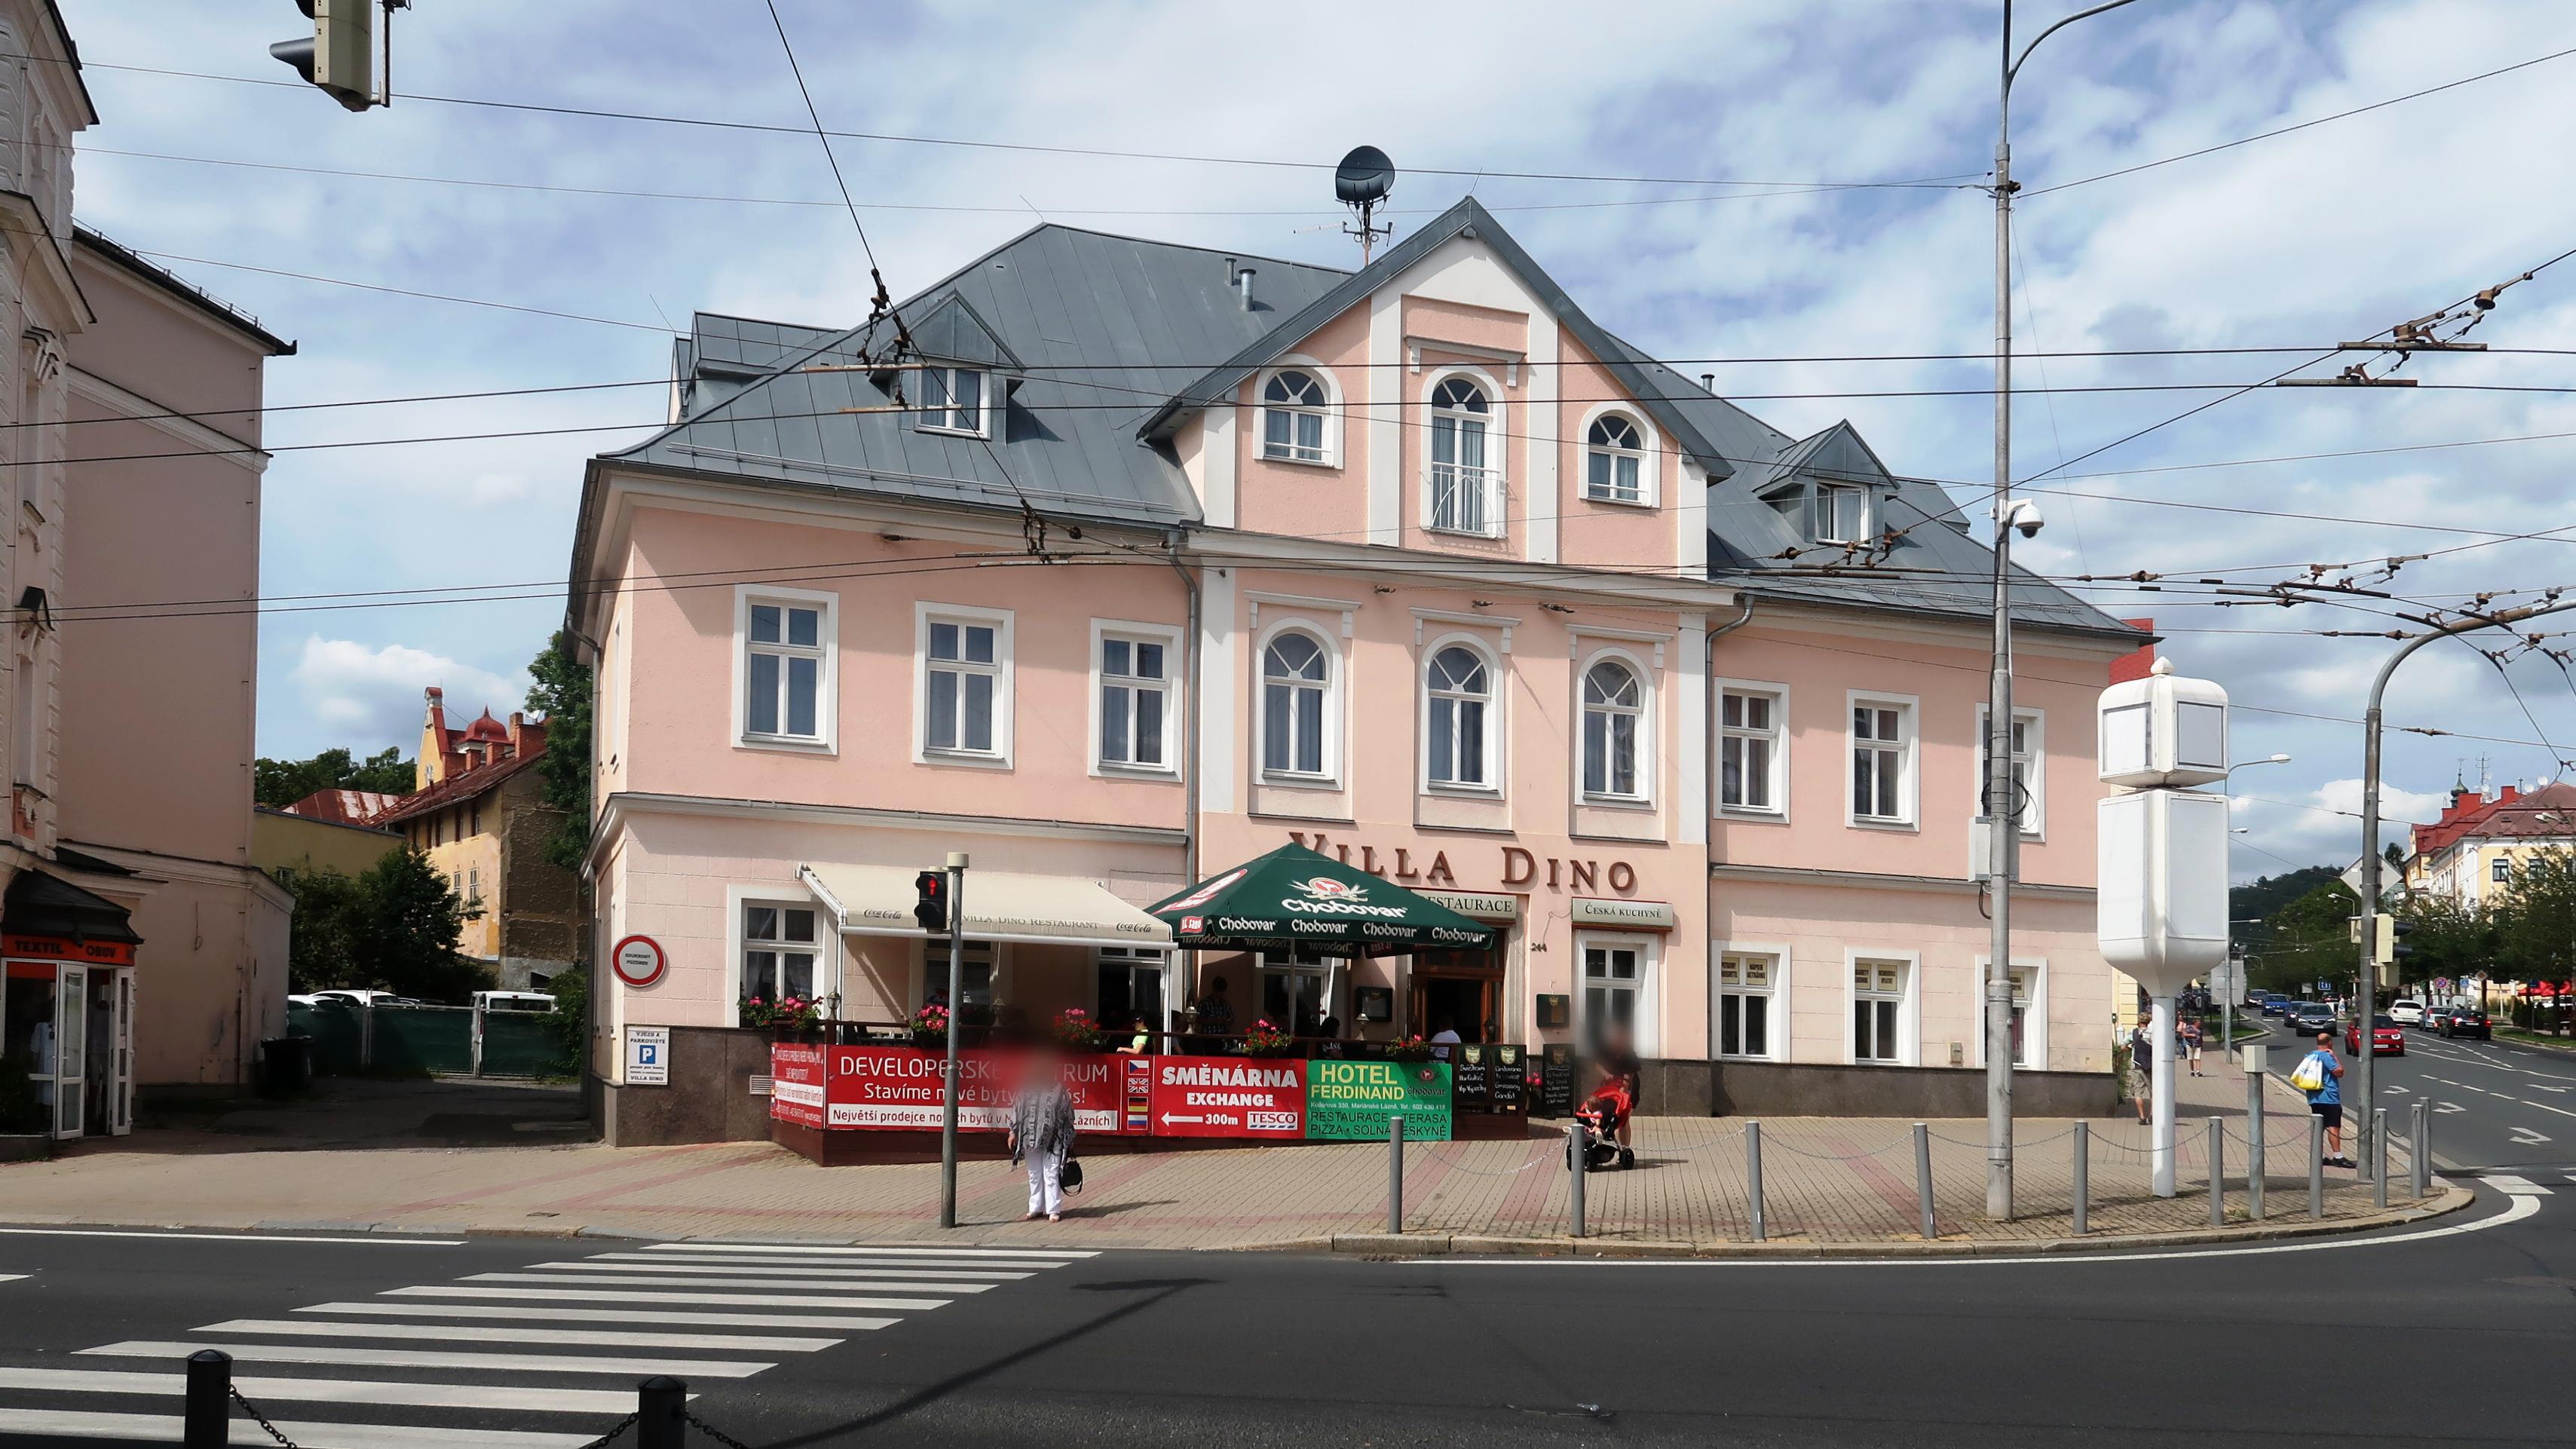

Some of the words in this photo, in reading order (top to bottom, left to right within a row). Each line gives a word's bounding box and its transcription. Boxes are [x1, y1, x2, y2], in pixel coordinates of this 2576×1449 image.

[1501, 846, 1634, 890] DINO
[1281, 898, 1406, 918] Chodovar
[1428, 896, 1512, 912] STAURACE
[963, 914, 993, 923] VILLA
[998, 917, 1026, 925] DINO
[1031, 918, 1099, 930] RESTAURANT
[1219, 916, 1276, 932] Chodovar
[1291, 919, 1348, 934] Chodovar
[1363, 922, 1417, 938] Chodovar
[1432, 927, 1486, 942] Chodovar
[15, 940, 64, 954] TEXTIL
[1530, 942, 1547, 952] 244
[642, 1047, 653, 1061] P
[1162, 1063, 1298, 1087] SMĚNÁRNA
[1321, 1064, 1398, 1085] HOTEL
[864, 1083, 931, 1100] Stavíme
[936, 1085, 976, 1101] nvé
[1187, 1092, 1273, 1107] EXCHANGE
[1310, 1085, 1404, 1100] FERDINAND
[833, 1109, 878, 1123] Největší
[881, 1111, 926, 1124] prodejce
[1205, 1114, 1239, 1125] 300m
[1249, 1113, 1296, 1124] TESCO
[1310, 1111, 1389, 1123] RESTAURACE
[1402, 1113, 1447, 1123] TERASA
[1310, 1124, 1343, 1135] PIZZA
[1353, 1123, 1391, 1135] SOLNÁ
[1403, 1124, 1447, 1136] ESKYNĚ
